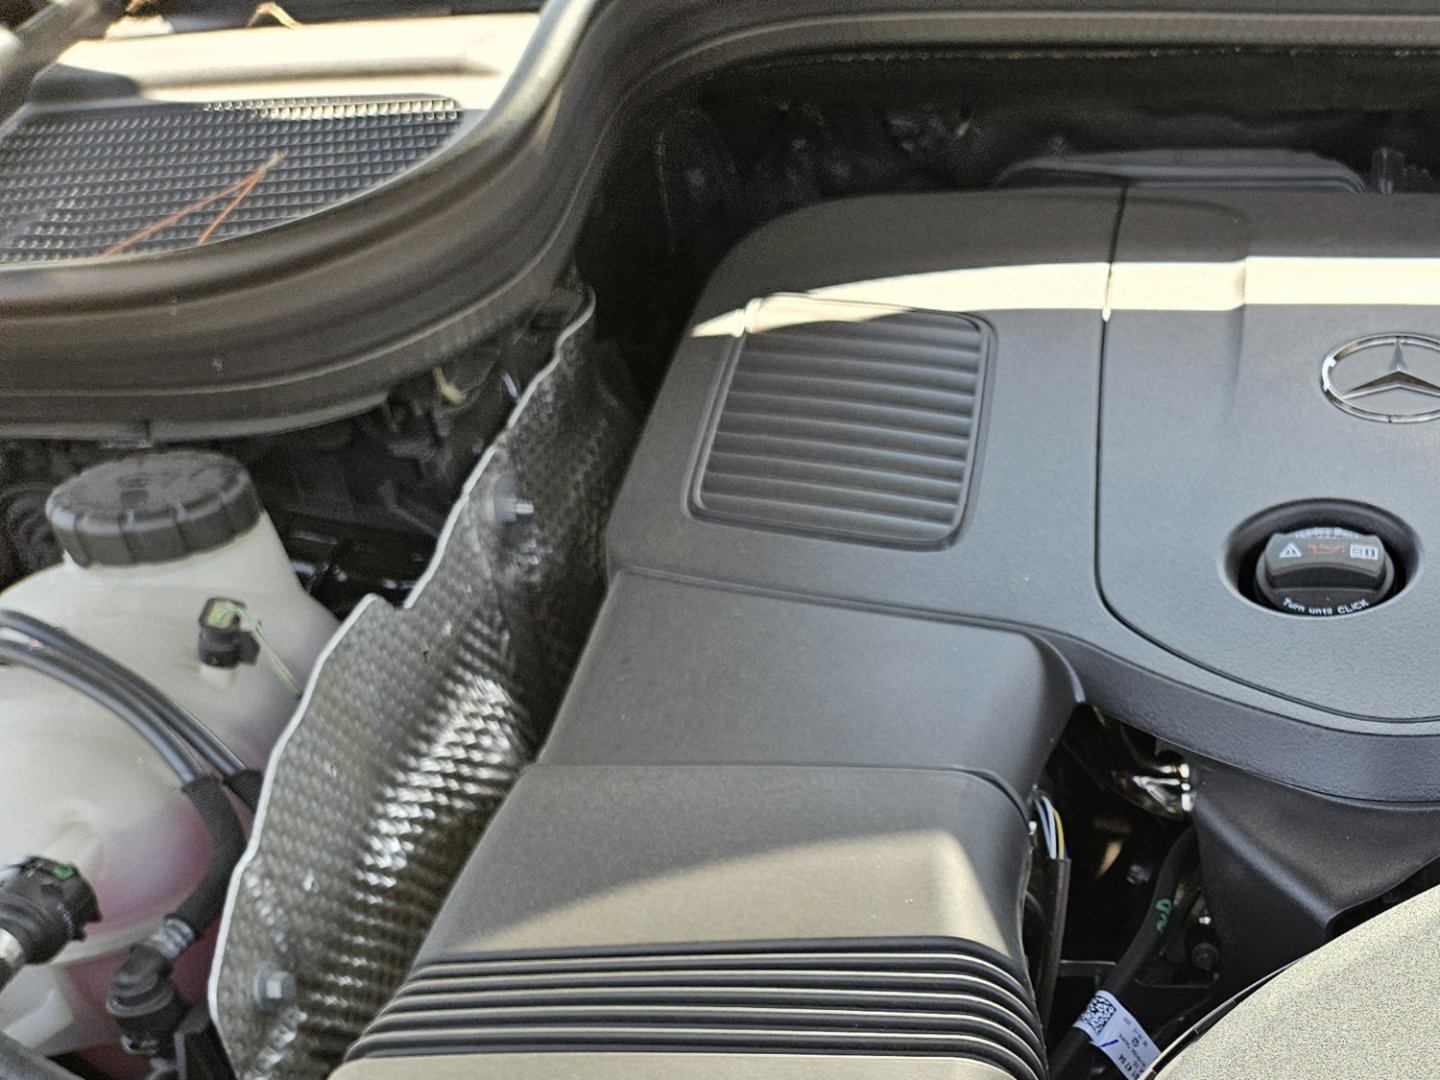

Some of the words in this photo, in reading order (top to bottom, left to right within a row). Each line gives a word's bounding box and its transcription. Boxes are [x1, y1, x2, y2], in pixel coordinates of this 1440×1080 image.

[1283, 597, 1305, 613] Turn
[1308, 606, 1333, 615] until
[1337, 597, 1369, 614] CLICK
